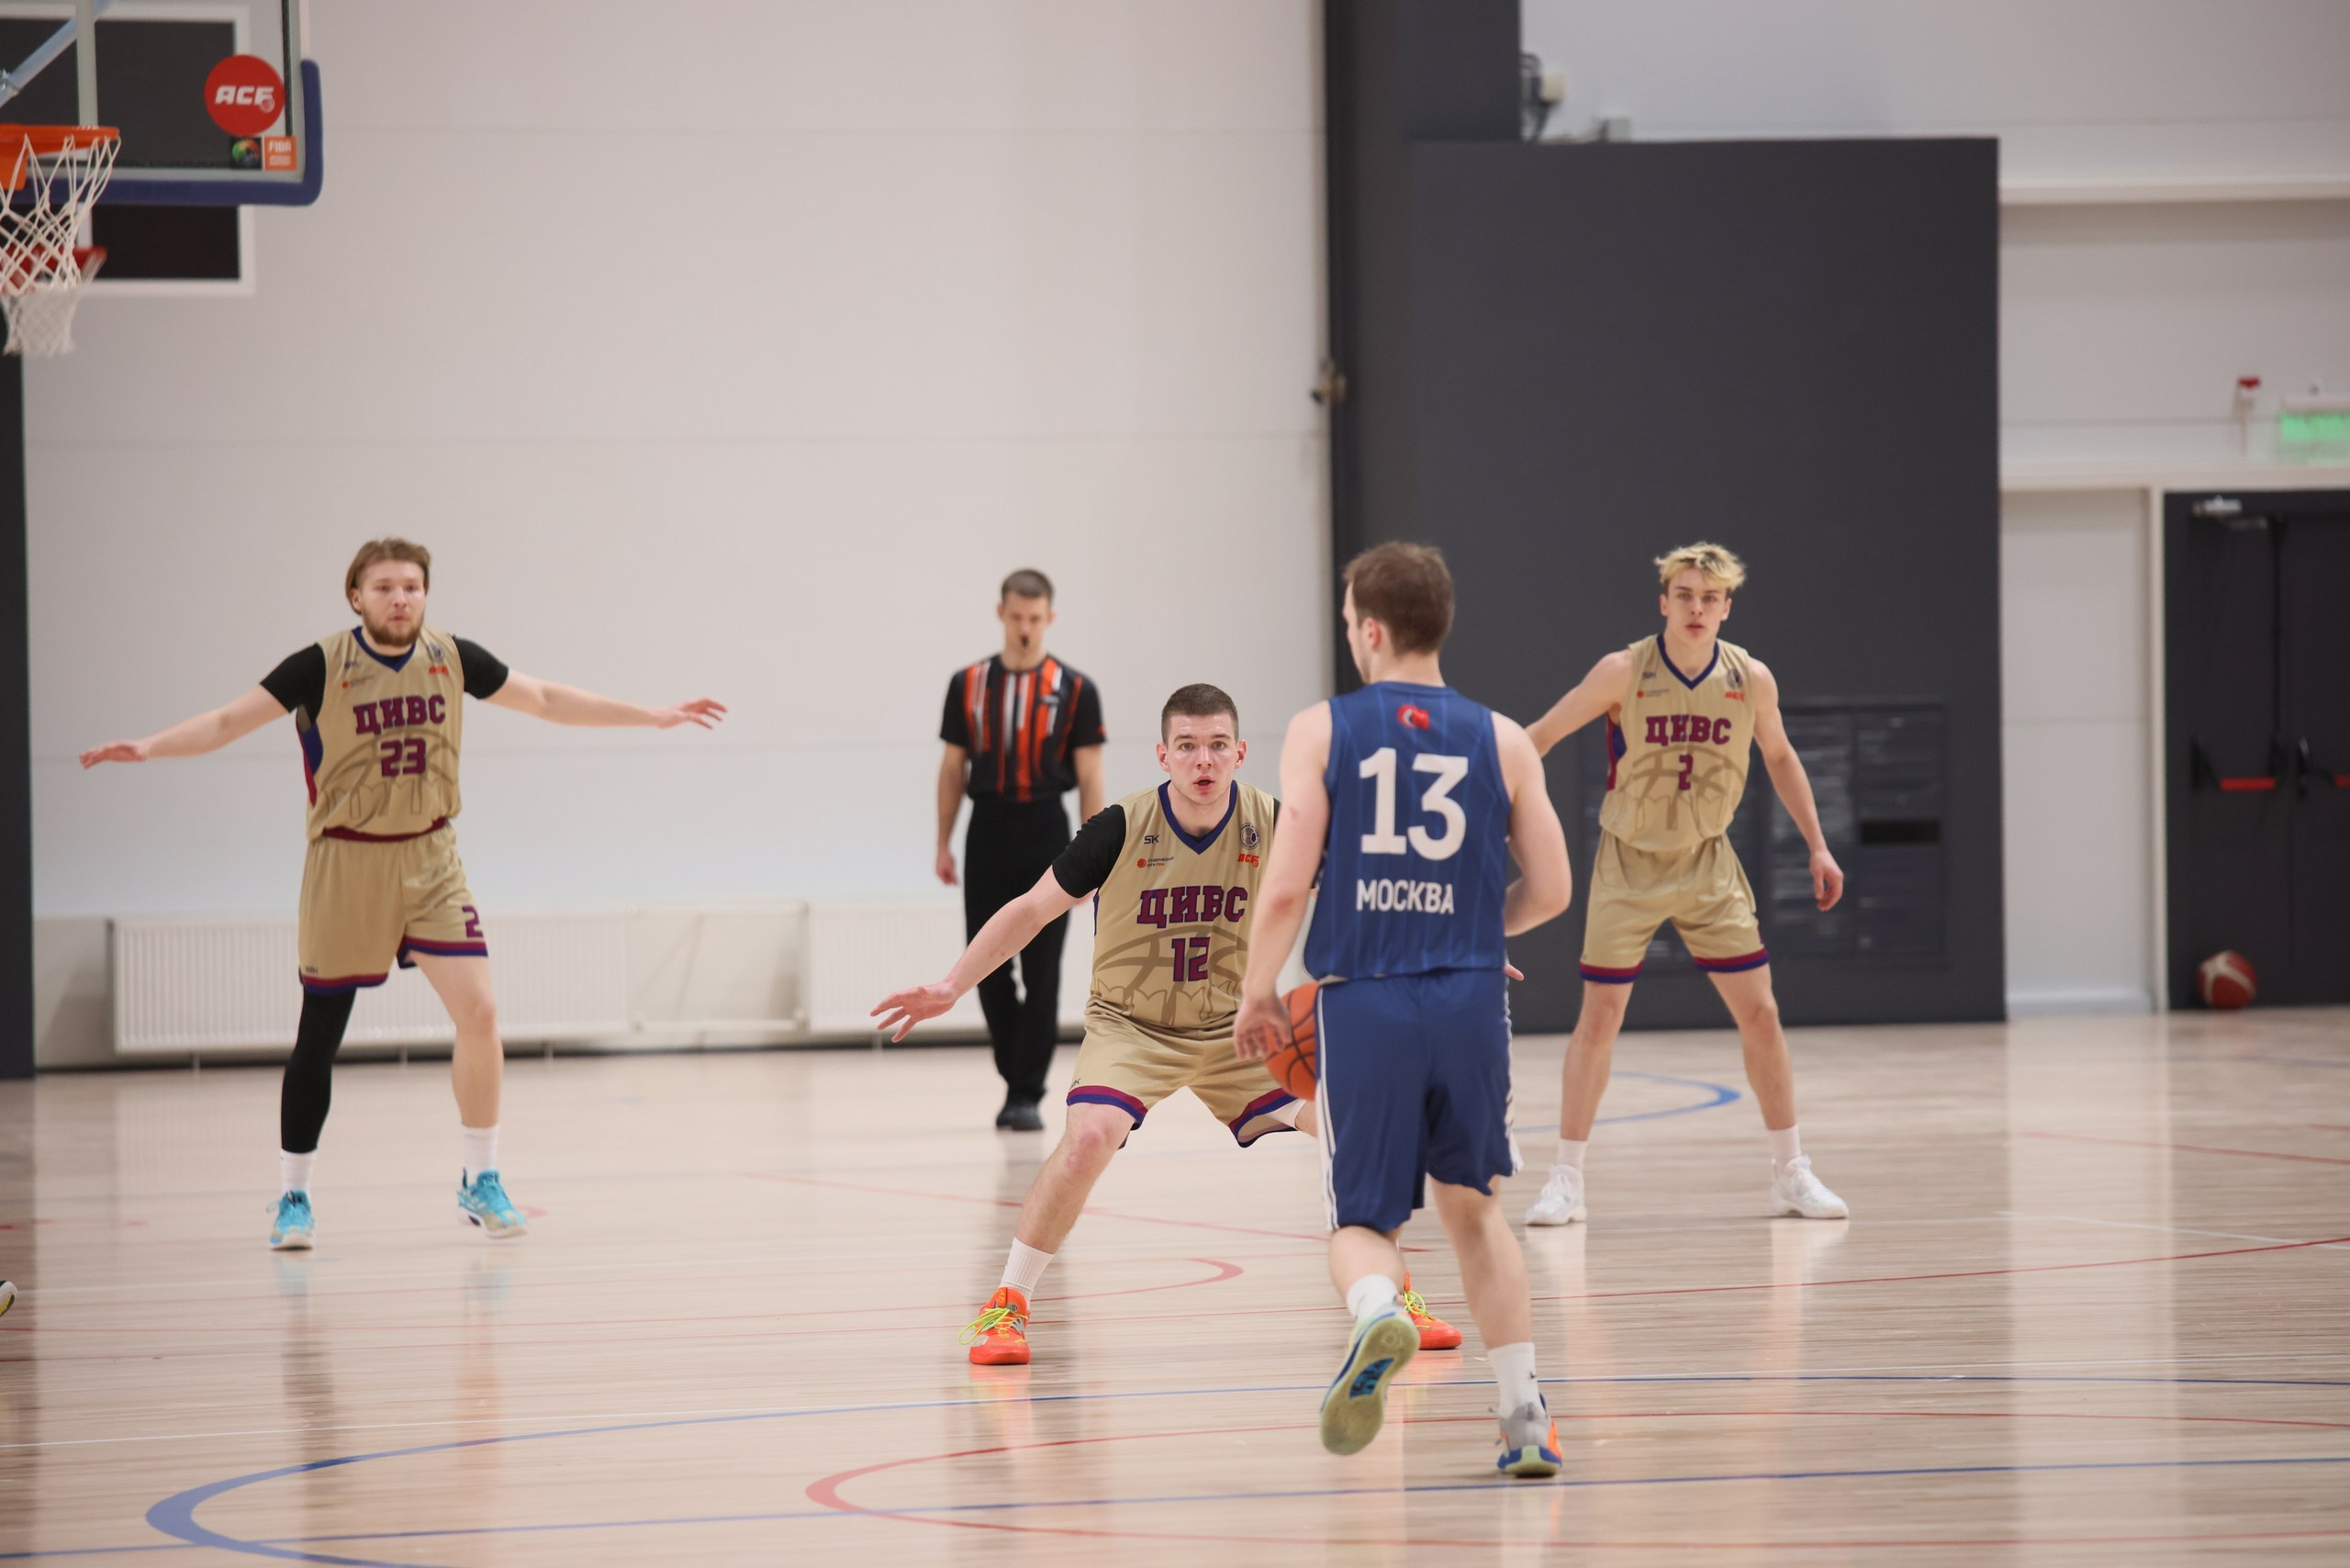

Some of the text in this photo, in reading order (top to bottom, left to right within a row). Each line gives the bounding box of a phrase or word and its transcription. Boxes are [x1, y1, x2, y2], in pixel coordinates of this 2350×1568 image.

[352, 693, 446, 736] ЦИВС
[1645, 714, 1732, 746] ЦИВС
[380, 737, 427, 778] 23
[1678, 754, 1694, 790] 2
[1359, 747, 1469, 861] 13
[1144, 834, 1159, 845] SK
[1136, 885, 1248, 929] ЦИВС
[1356, 879, 1455, 914] МОСКВА
[1171, 936, 1211, 982] 12
